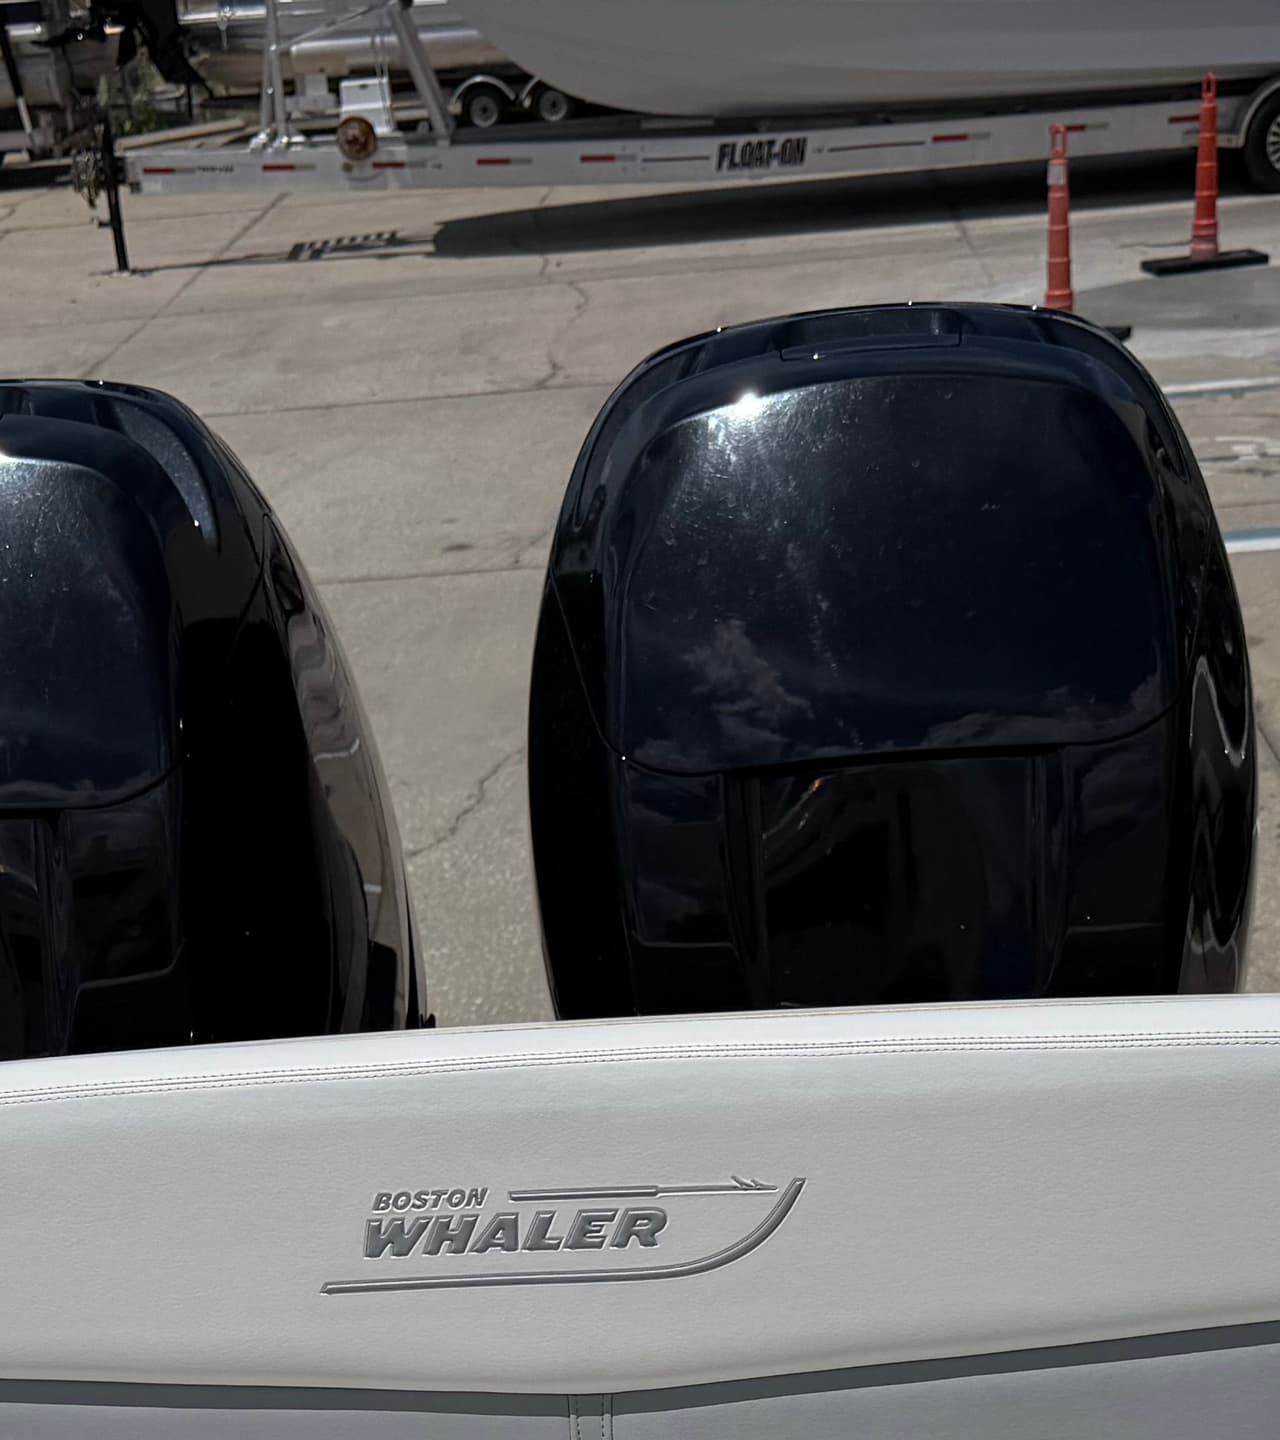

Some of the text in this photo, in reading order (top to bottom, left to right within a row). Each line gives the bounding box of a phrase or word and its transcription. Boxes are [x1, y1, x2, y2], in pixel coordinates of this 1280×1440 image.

[716, 136, 808, 171] FLOAT-ON
[372, 1186, 489, 1213] BOSTON
[363, 1207, 668, 1259] WHALER
